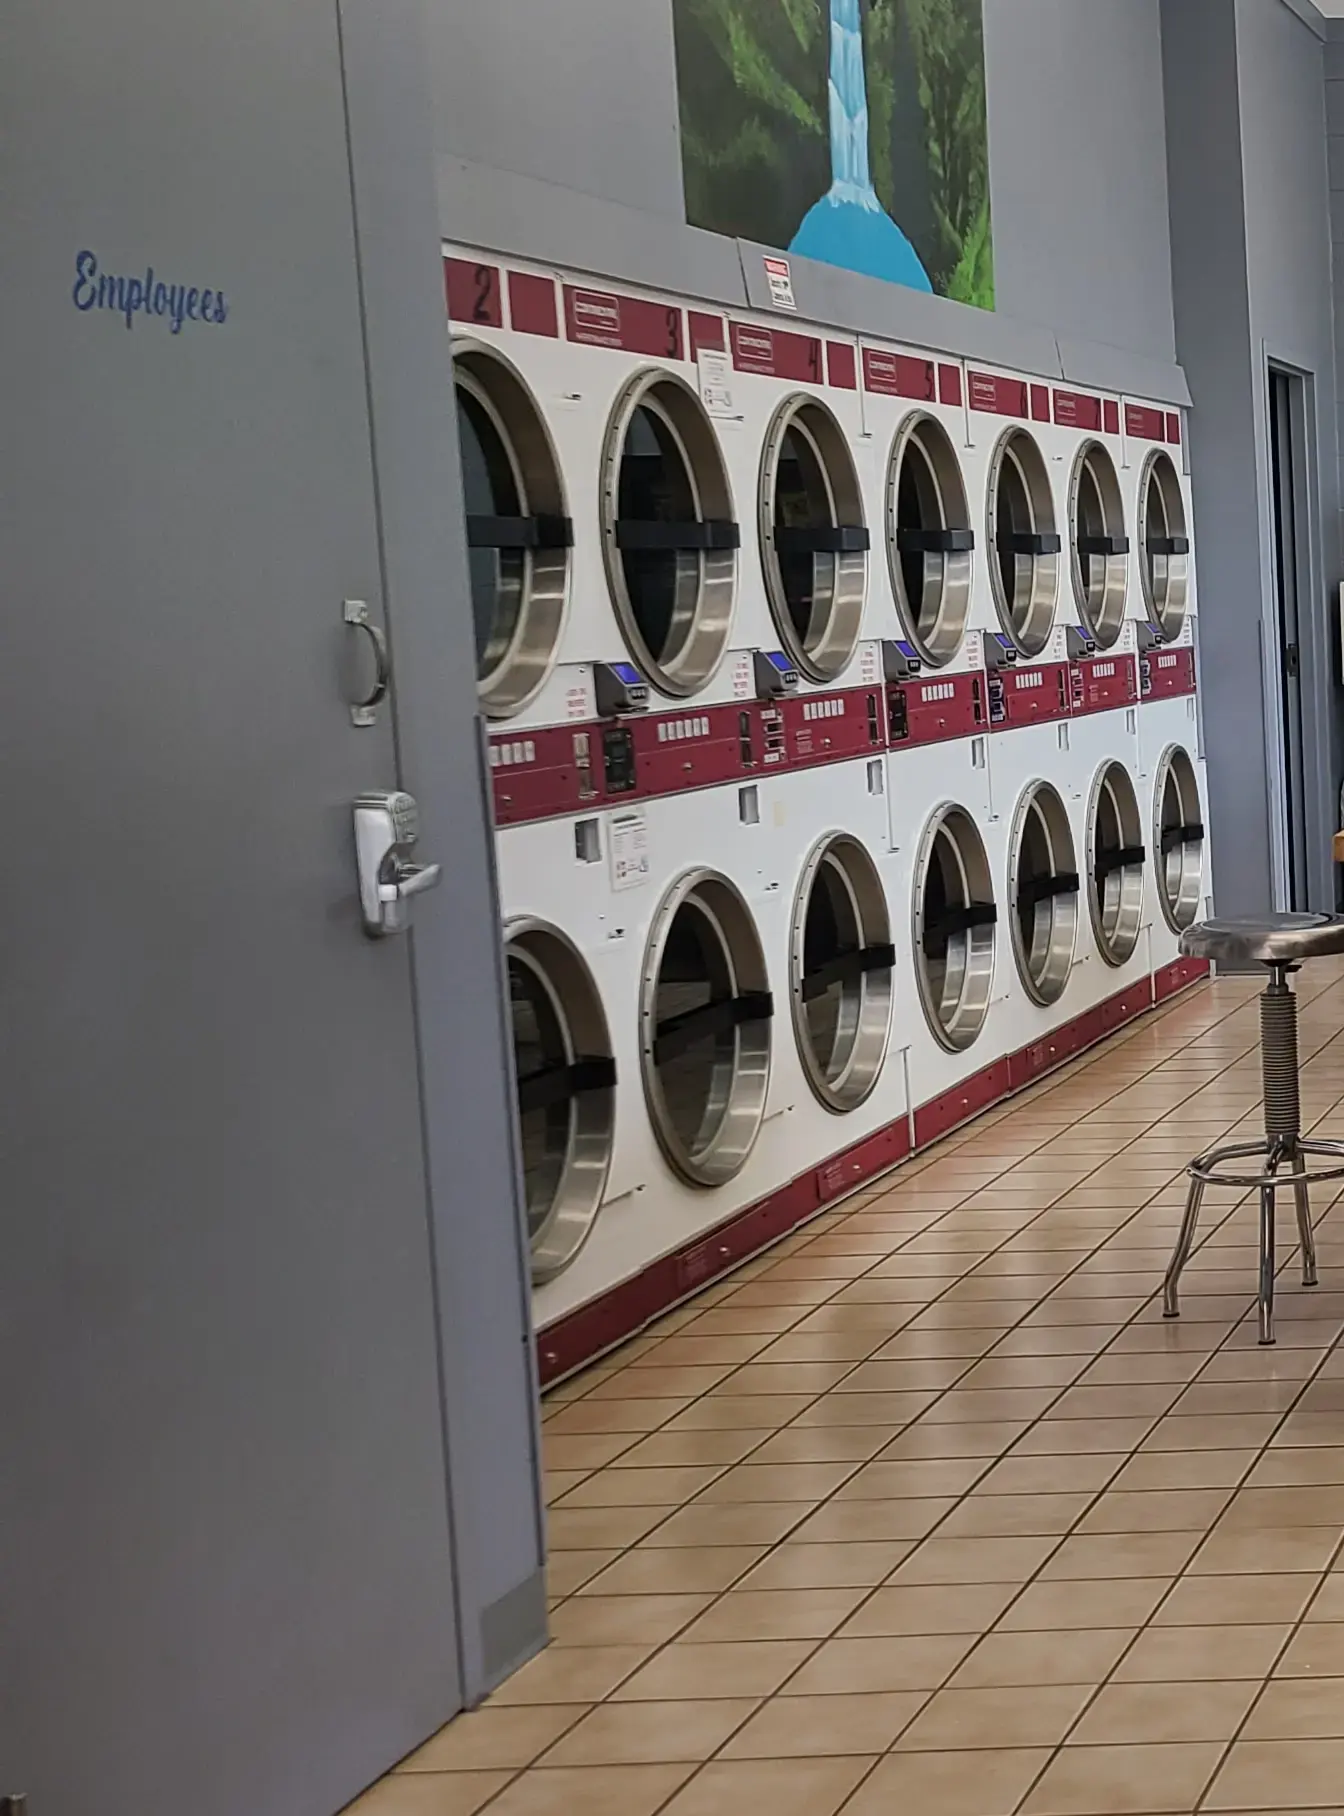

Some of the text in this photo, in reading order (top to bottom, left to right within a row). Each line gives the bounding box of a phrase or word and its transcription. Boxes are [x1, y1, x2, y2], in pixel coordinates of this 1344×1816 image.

[73, 250, 228, 333] Employees
[472, 266, 490, 320] 2
[666, 308, 678, 358] 3
